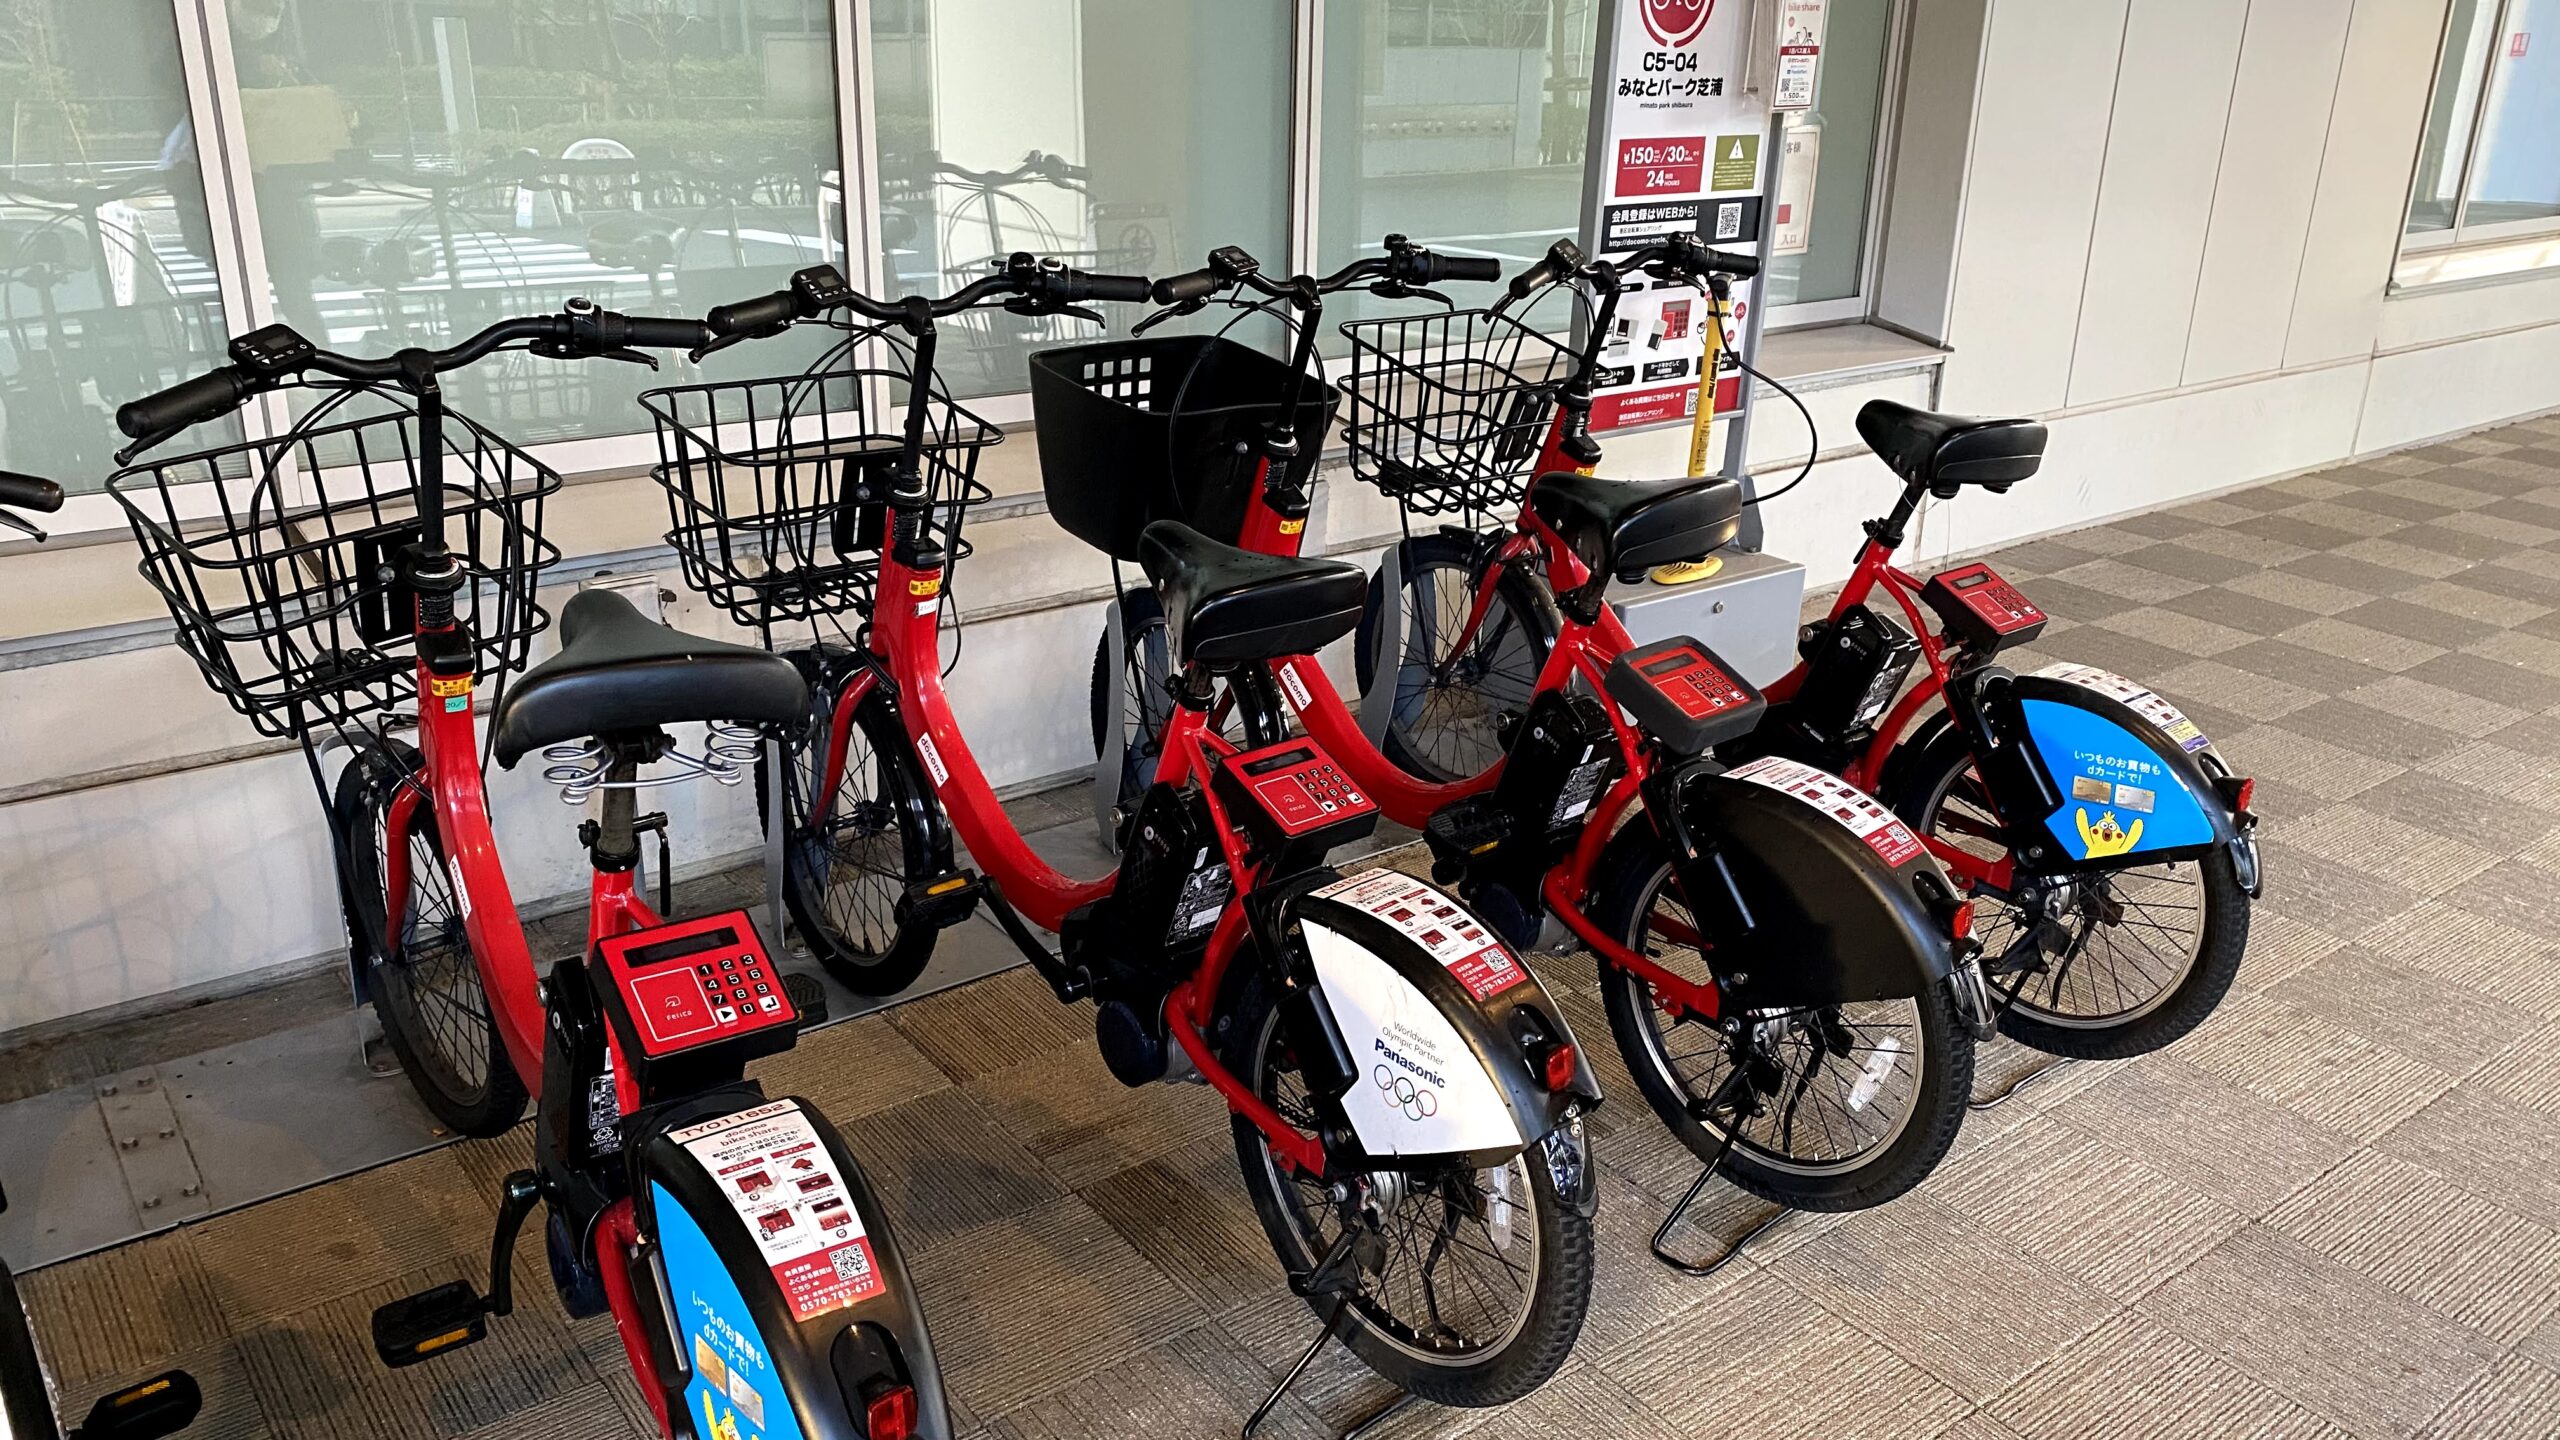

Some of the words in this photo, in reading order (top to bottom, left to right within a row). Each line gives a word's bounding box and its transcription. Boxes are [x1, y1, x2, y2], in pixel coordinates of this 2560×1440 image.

[1801, 3, 1820, 11] share
[1643, 52, 1697, 72] C5-04
[1618, 77, 1723, 97] みなとパーク芝浦
[1646, 170, 1665, 187] 24
[1611, 206, 1698, 223] 会員登録はWEBから!
[1781, 234, 1797, 245] 入口
[1283, 668, 1307, 706] docomo
[921, 738, 945, 782] docomo
[2074, 750, 2161, 776] いつものお買物も
[1311, 769, 1320, 777] 2
[1324, 765, 1333, 773] 3
[2087, 765, 2142, 784] dカードで!
[452, 861, 468, 914] docomo
[701, 966, 710, 975] 1
[722, 960, 732, 970] 2
[743, 955, 754, 965] 3
[707, 980, 718, 989] 4
[728, 975, 739, 985] 5
[750, 970, 761, 980] 6
[714, 994, 724, 1004] 7
[735, 989, 747, 999] 8
[757, 983, 768, 994] 9
[665, 1009, 693, 1021] FeliCa
[743, 1004, 754, 1014] 0
[1382, 1026, 1413, 1050] Olympic
[1413, 1043, 1445, 1066] Partner
[1394, 1021, 1437, 1051] Worldwide
[1375, 1037, 1446, 1089] Panasonic
[680, 1103, 786, 1137] TYO11652
[720, 1135, 746, 1147] bike
[747, 1126, 779, 1138] share
[724, 1123, 768, 1139] docomo
[792, 1283, 812, 1294] こちら
[800, 1280, 874, 1312] 0570-783-677
[692, 1290, 765, 1370] いつものお買物も
[703, 1323, 749, 1378] dカードで!
